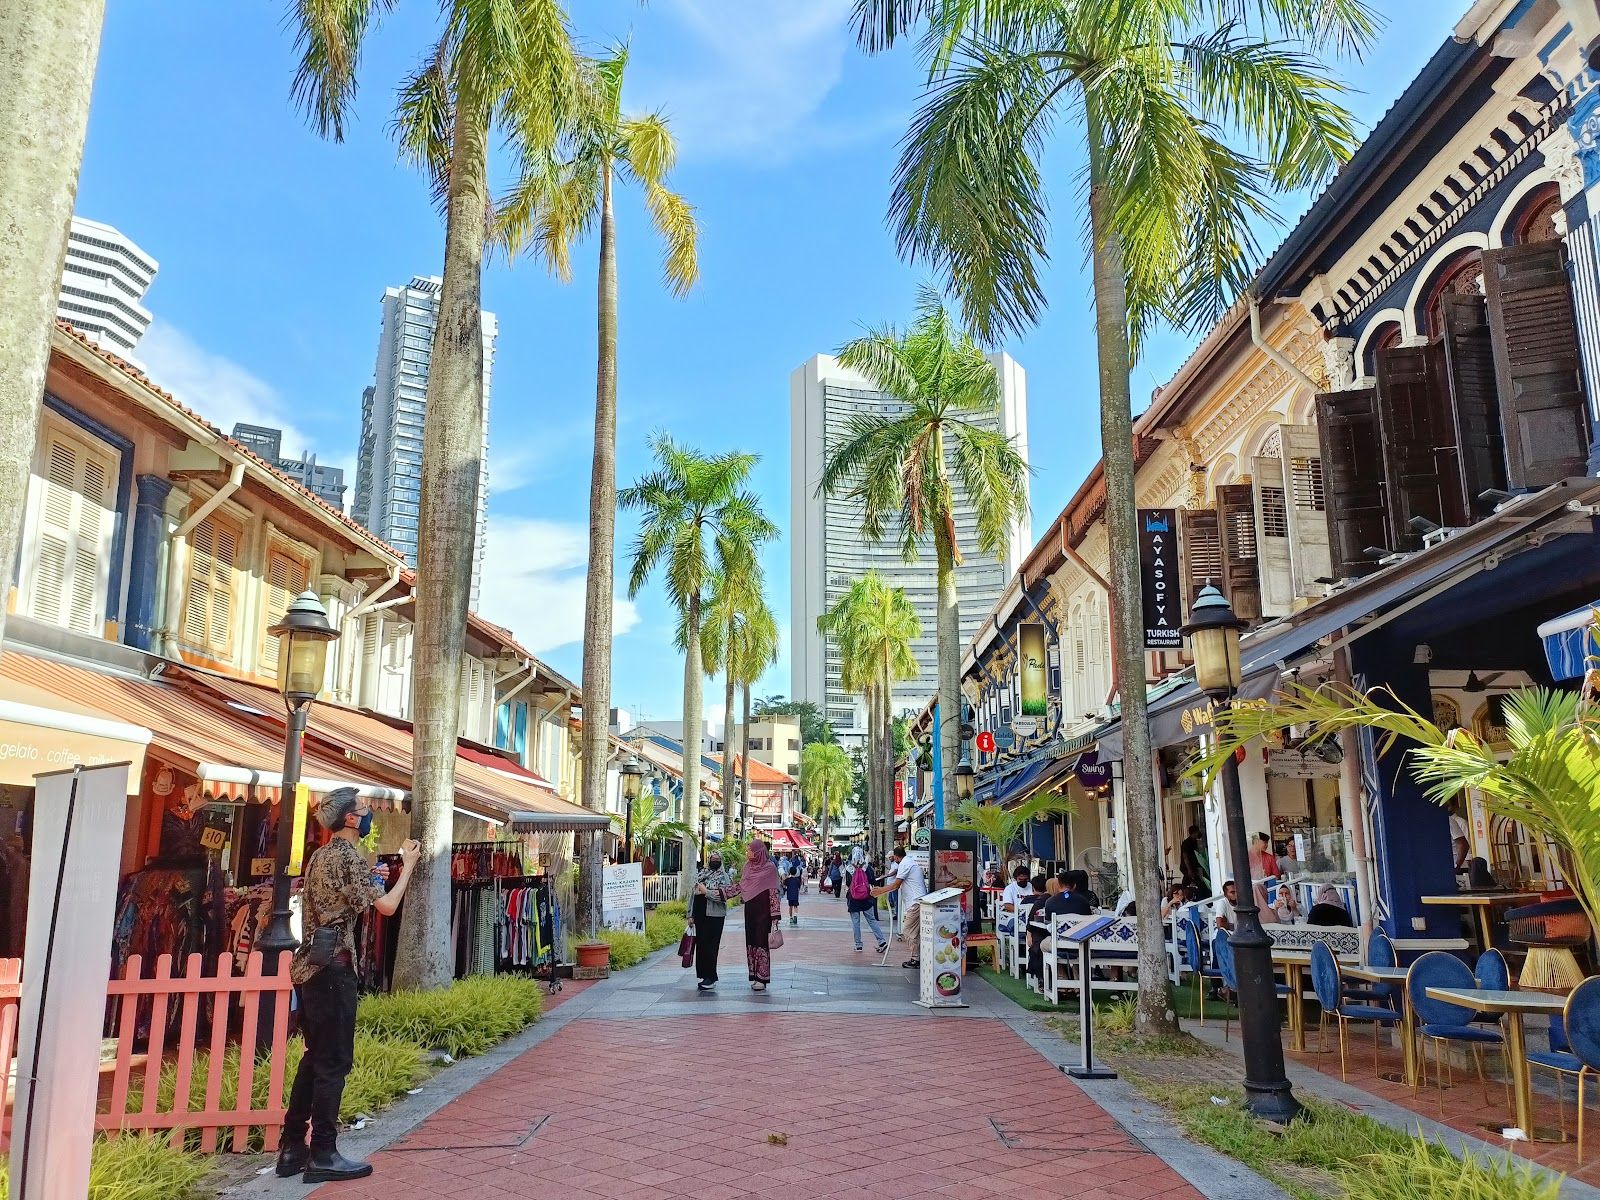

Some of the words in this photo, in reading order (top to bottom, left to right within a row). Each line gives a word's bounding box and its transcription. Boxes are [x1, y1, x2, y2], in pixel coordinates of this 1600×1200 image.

[1153, 534, 1168, 626] AYASOFYA
[1146, 628, 1180, 638] TURKISH
[0, 742, 39, 760] gelato
[47, 747, 81, 765] coffee
[1081, 763, 1105, 776] Swing
[205, 830, 222, 845] $10
[255, 862, 272, 874] $3
